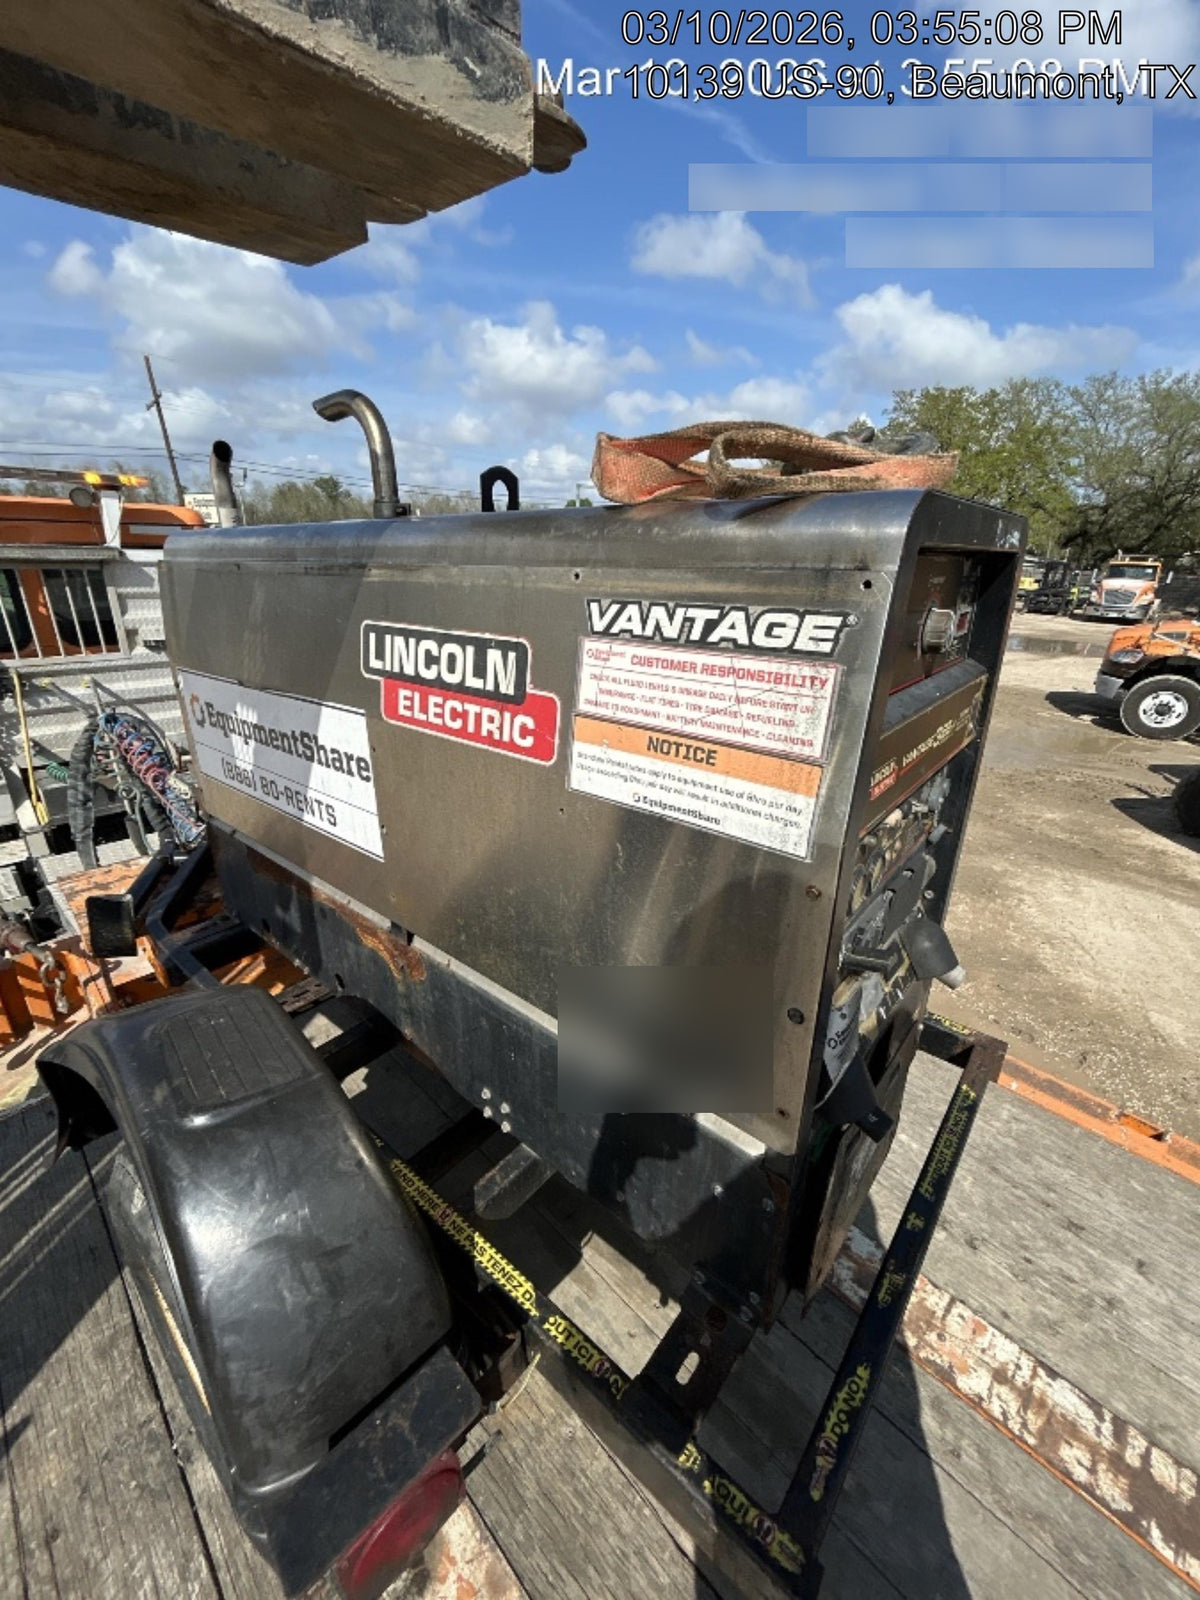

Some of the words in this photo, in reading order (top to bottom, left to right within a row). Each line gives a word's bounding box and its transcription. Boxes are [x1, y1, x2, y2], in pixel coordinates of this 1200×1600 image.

[587, 600, 844, 655] VANTAGE
[368, 631, 517, 697] LINCOLN
[631, 655, 697, 674] CUSTOMER
[700, 663, 829, 690] RESPONSIBILITY
[204, 701, 372, 783] EquipmentShare
[397, 687, 536, 749] ELECTRIC
[646, 735, 718, 767] NOTICE
[259, 776, 338, 828] 80-RENTS
[487, 1255, 524, 1292] TENEZ
